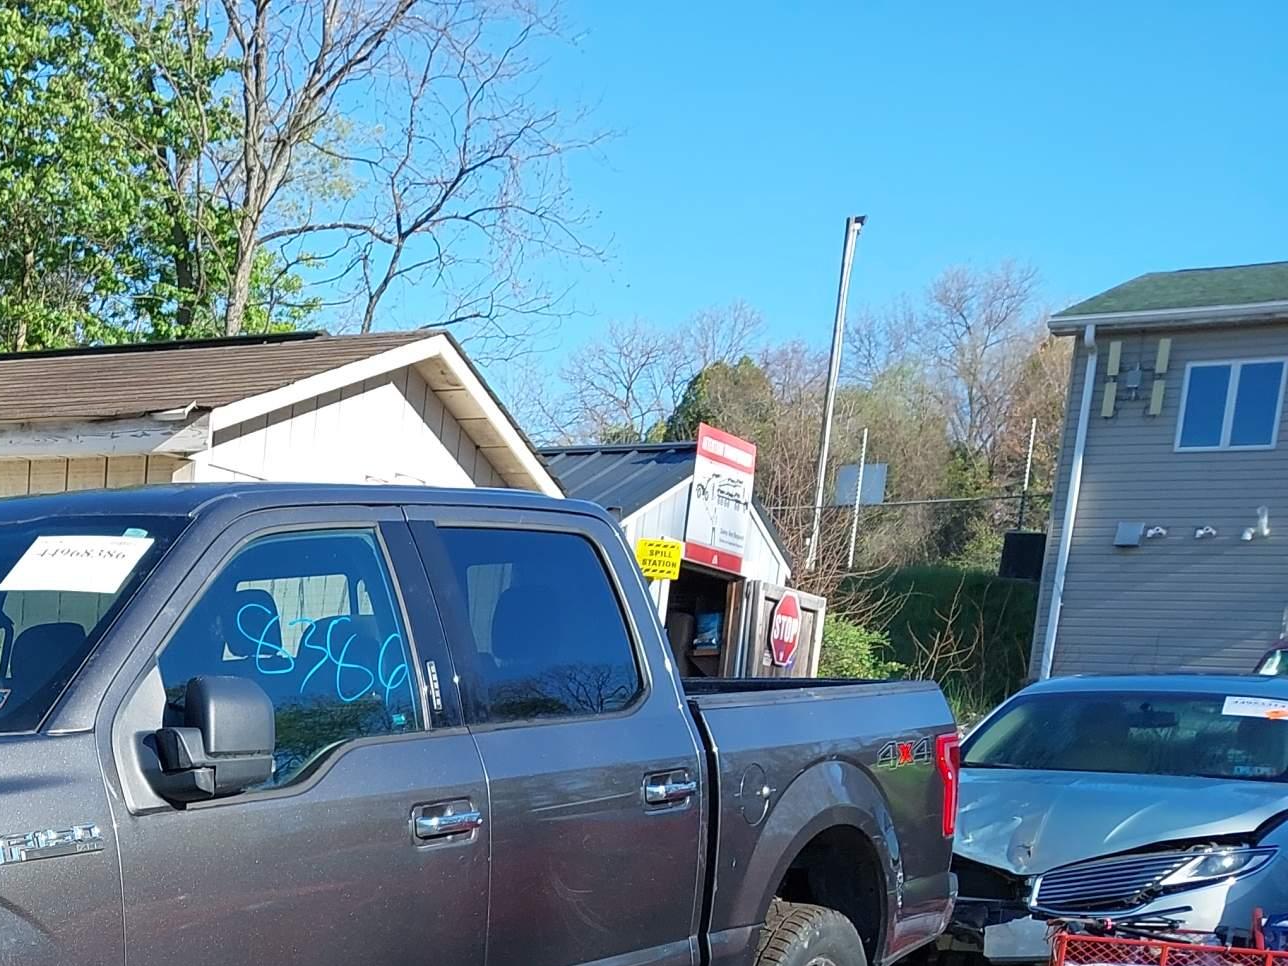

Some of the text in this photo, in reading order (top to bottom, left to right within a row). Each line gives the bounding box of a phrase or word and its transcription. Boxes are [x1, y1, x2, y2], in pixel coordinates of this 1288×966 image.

[649, 549, 673, 559] SPILL
[641, 558, 677, 569] STATION
[774, 614, 799, 643] STOP
